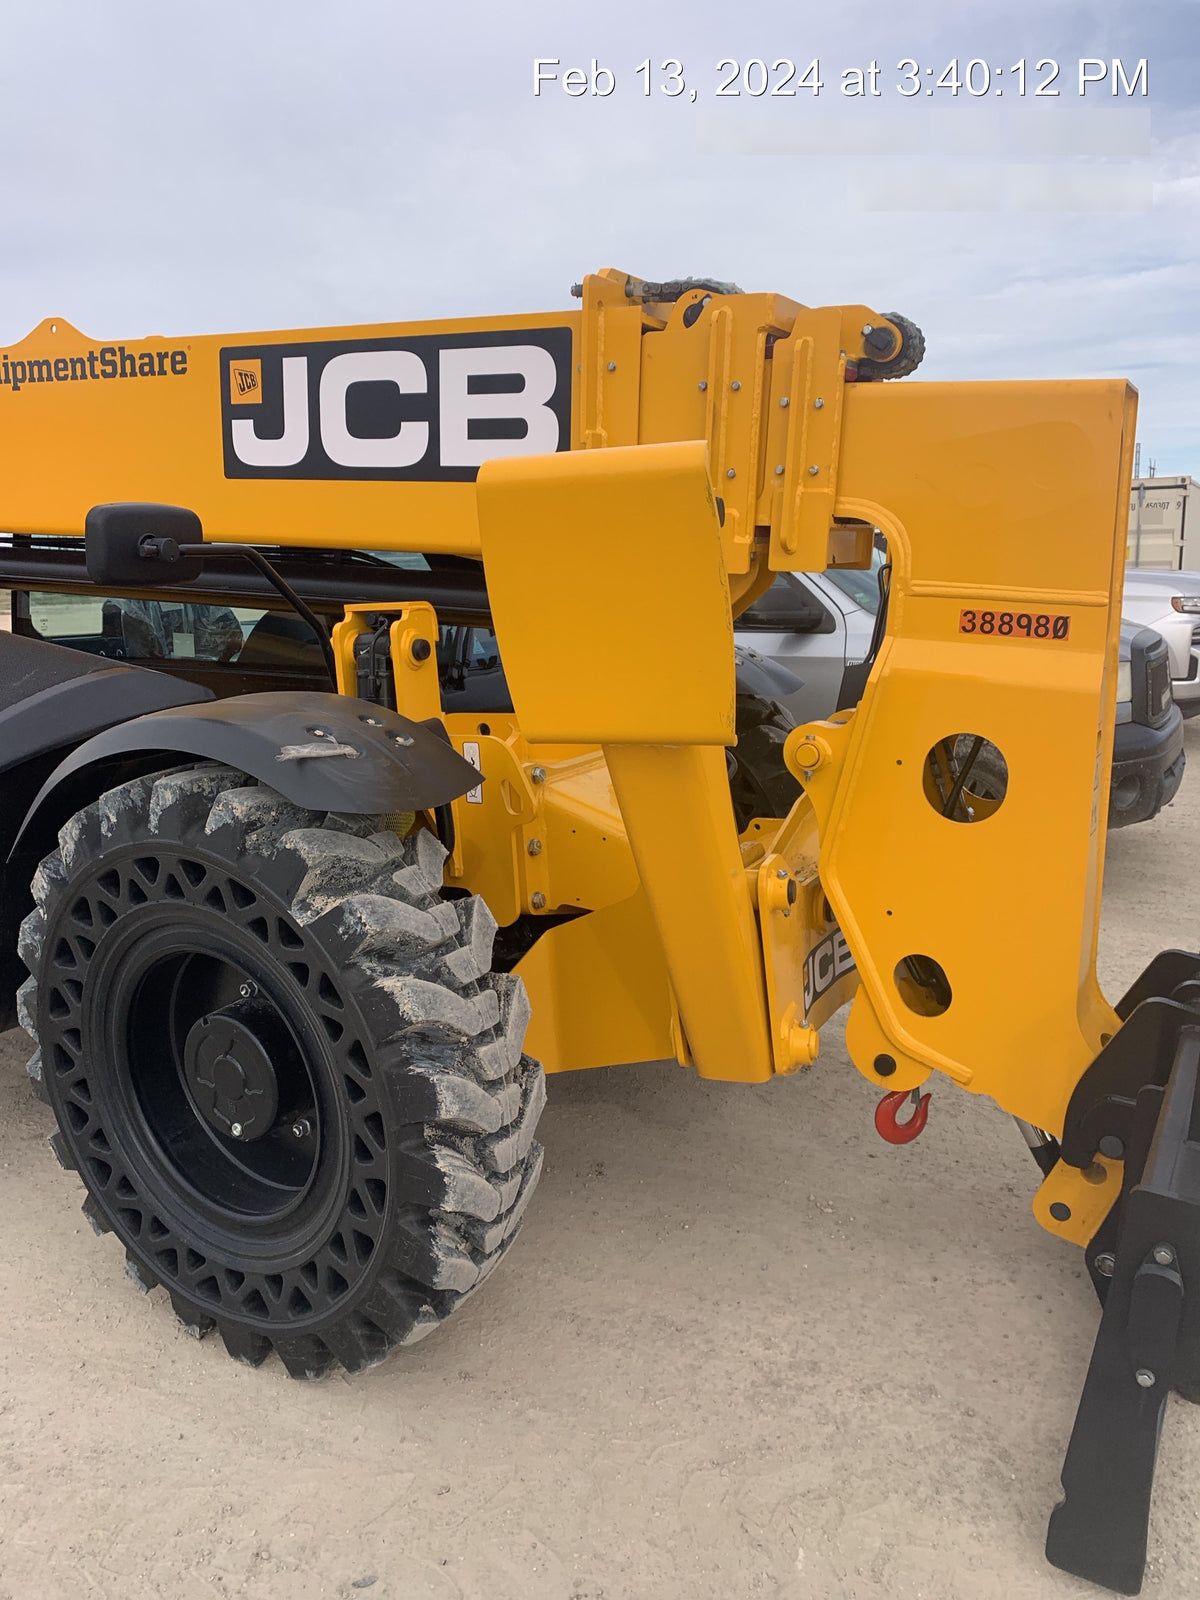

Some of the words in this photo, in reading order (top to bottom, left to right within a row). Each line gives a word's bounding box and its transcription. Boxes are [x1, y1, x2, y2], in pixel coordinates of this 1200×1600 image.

[0, 346, 188, 391] ipmentShare
[238, 371, 257, 393] JCB
[232, 345, 559, 467] JCB
[961, 610, 1070, 639] 388980
